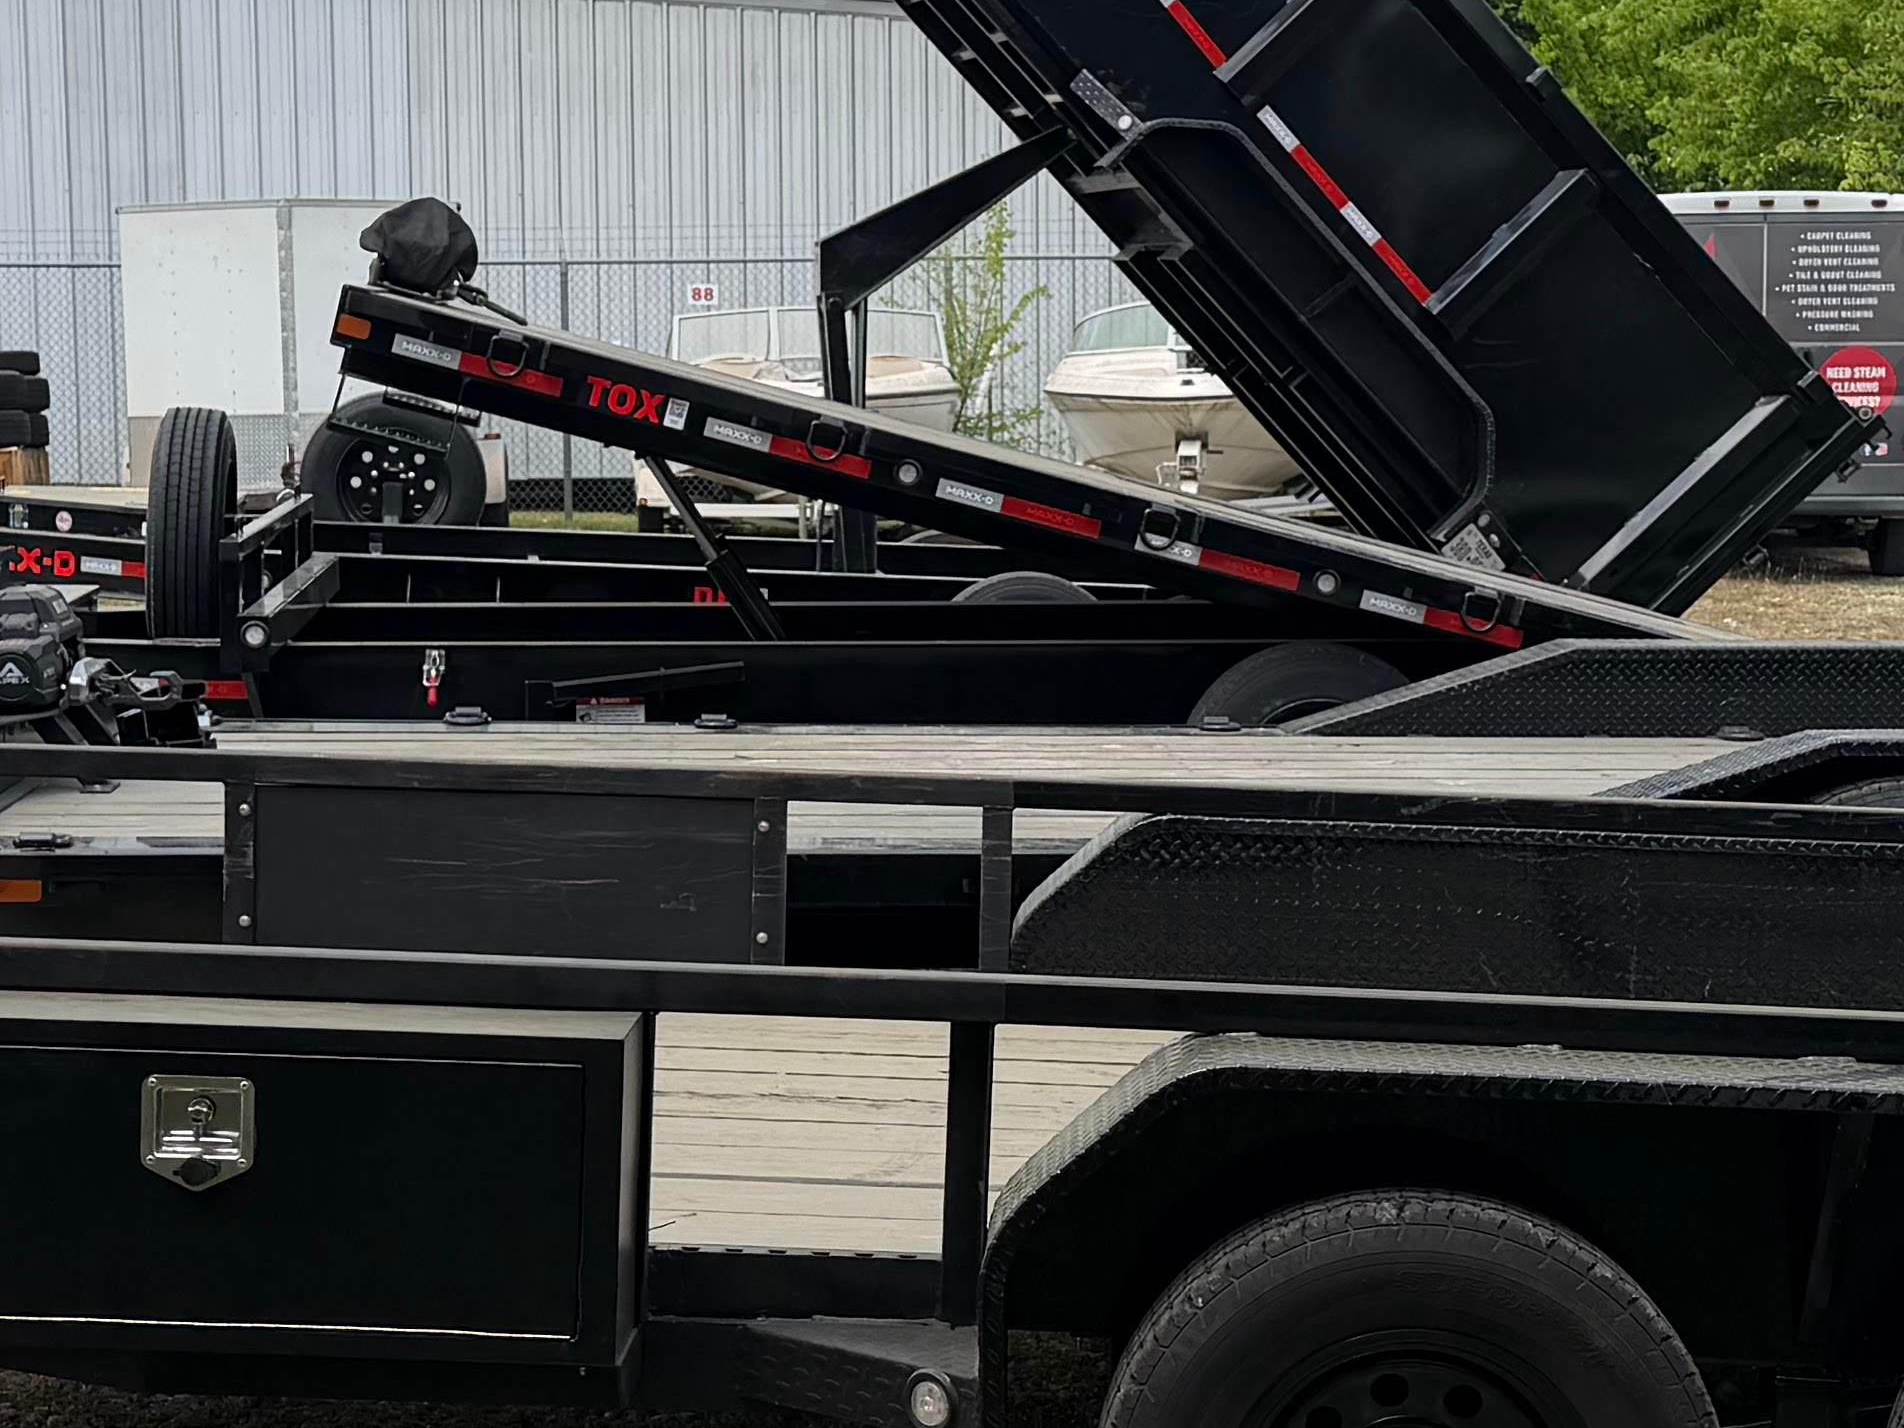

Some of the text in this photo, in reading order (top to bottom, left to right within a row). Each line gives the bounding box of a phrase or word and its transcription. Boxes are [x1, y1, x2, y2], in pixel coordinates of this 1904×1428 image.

[1807, 231, 1871, 240] CARPET CLEANING
[1845, 244, 1880, 253] CLEANING
[1843, 257, 1879, 266] CLEANING
[1846, 270, 1882, 279] CLEANING
[1782, 283, 1795, 292] PET
[1797, 283, 1818, 292] STAIN
[1849, 283, 1895, 292] TREATMENTS
[691, 287, 714, 302] 88
[1843, 297, 1878, 305] CLEANING
[1802, 310, 1873, 319] PRESSURE WASHING
[1814, 323, 1860, 332] COMMERCIAL
[401, 340, 452, 361] MAXX-D
[1826, 367, 1886, 378] NEED STEAM
[1832, 381, 1880, 393] CLEANING
[587, 375, 665, 424] TOX
[712, 424, 763, 444] MAXX-D
[944, 485, 993, 505] MAXX-D
[1368, 597, 1417, 616] MAXX-D
